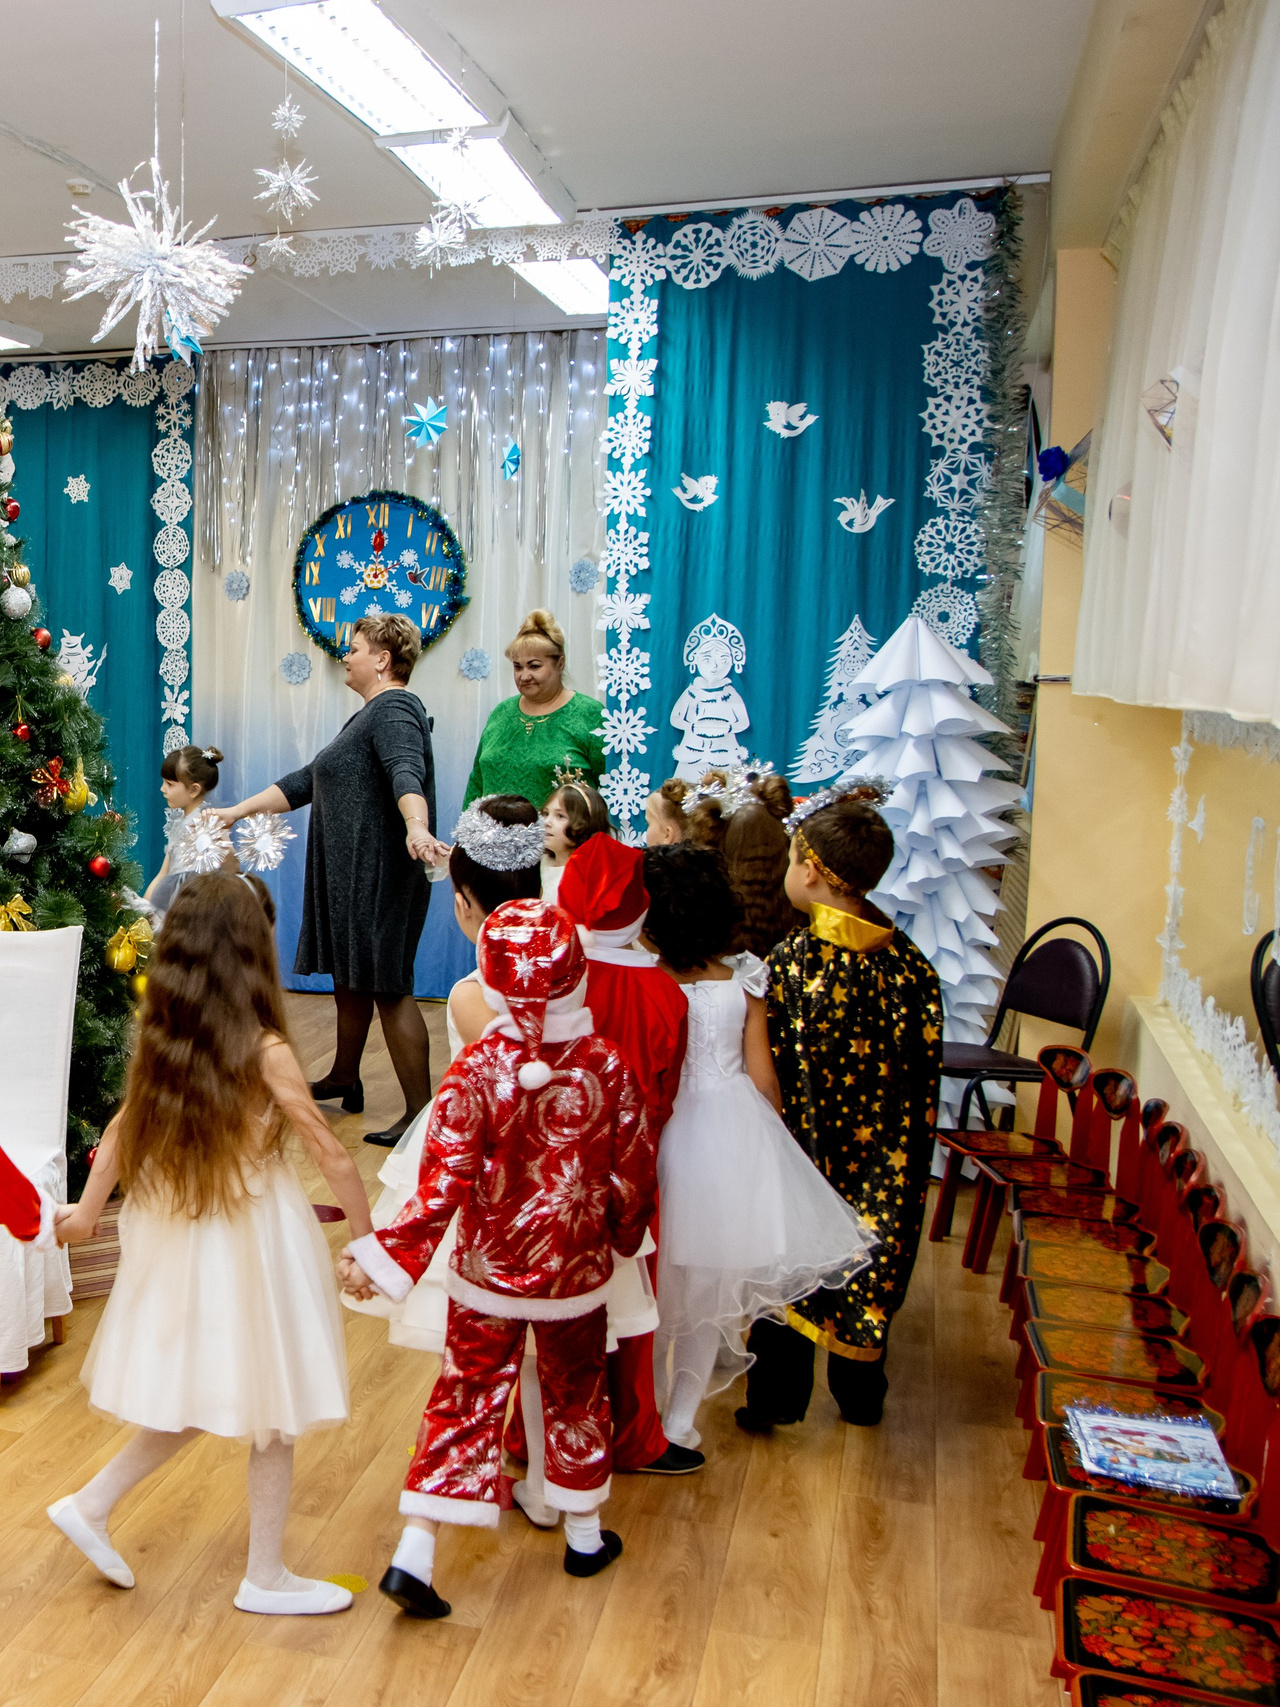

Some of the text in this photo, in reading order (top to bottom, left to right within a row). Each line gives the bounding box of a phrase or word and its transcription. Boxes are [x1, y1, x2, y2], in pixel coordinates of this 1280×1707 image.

[335, 514, 352, 539] XI
[366, 504, 389, 528] XII
[407, 514, 413, 538] I
[314, 534, 327, 557] X
[425, 532, 438, 556] II
[305, 561, 320, 586] IX
[429, 566, 448, 592] III
[308, 597, 336, 622] VIII
